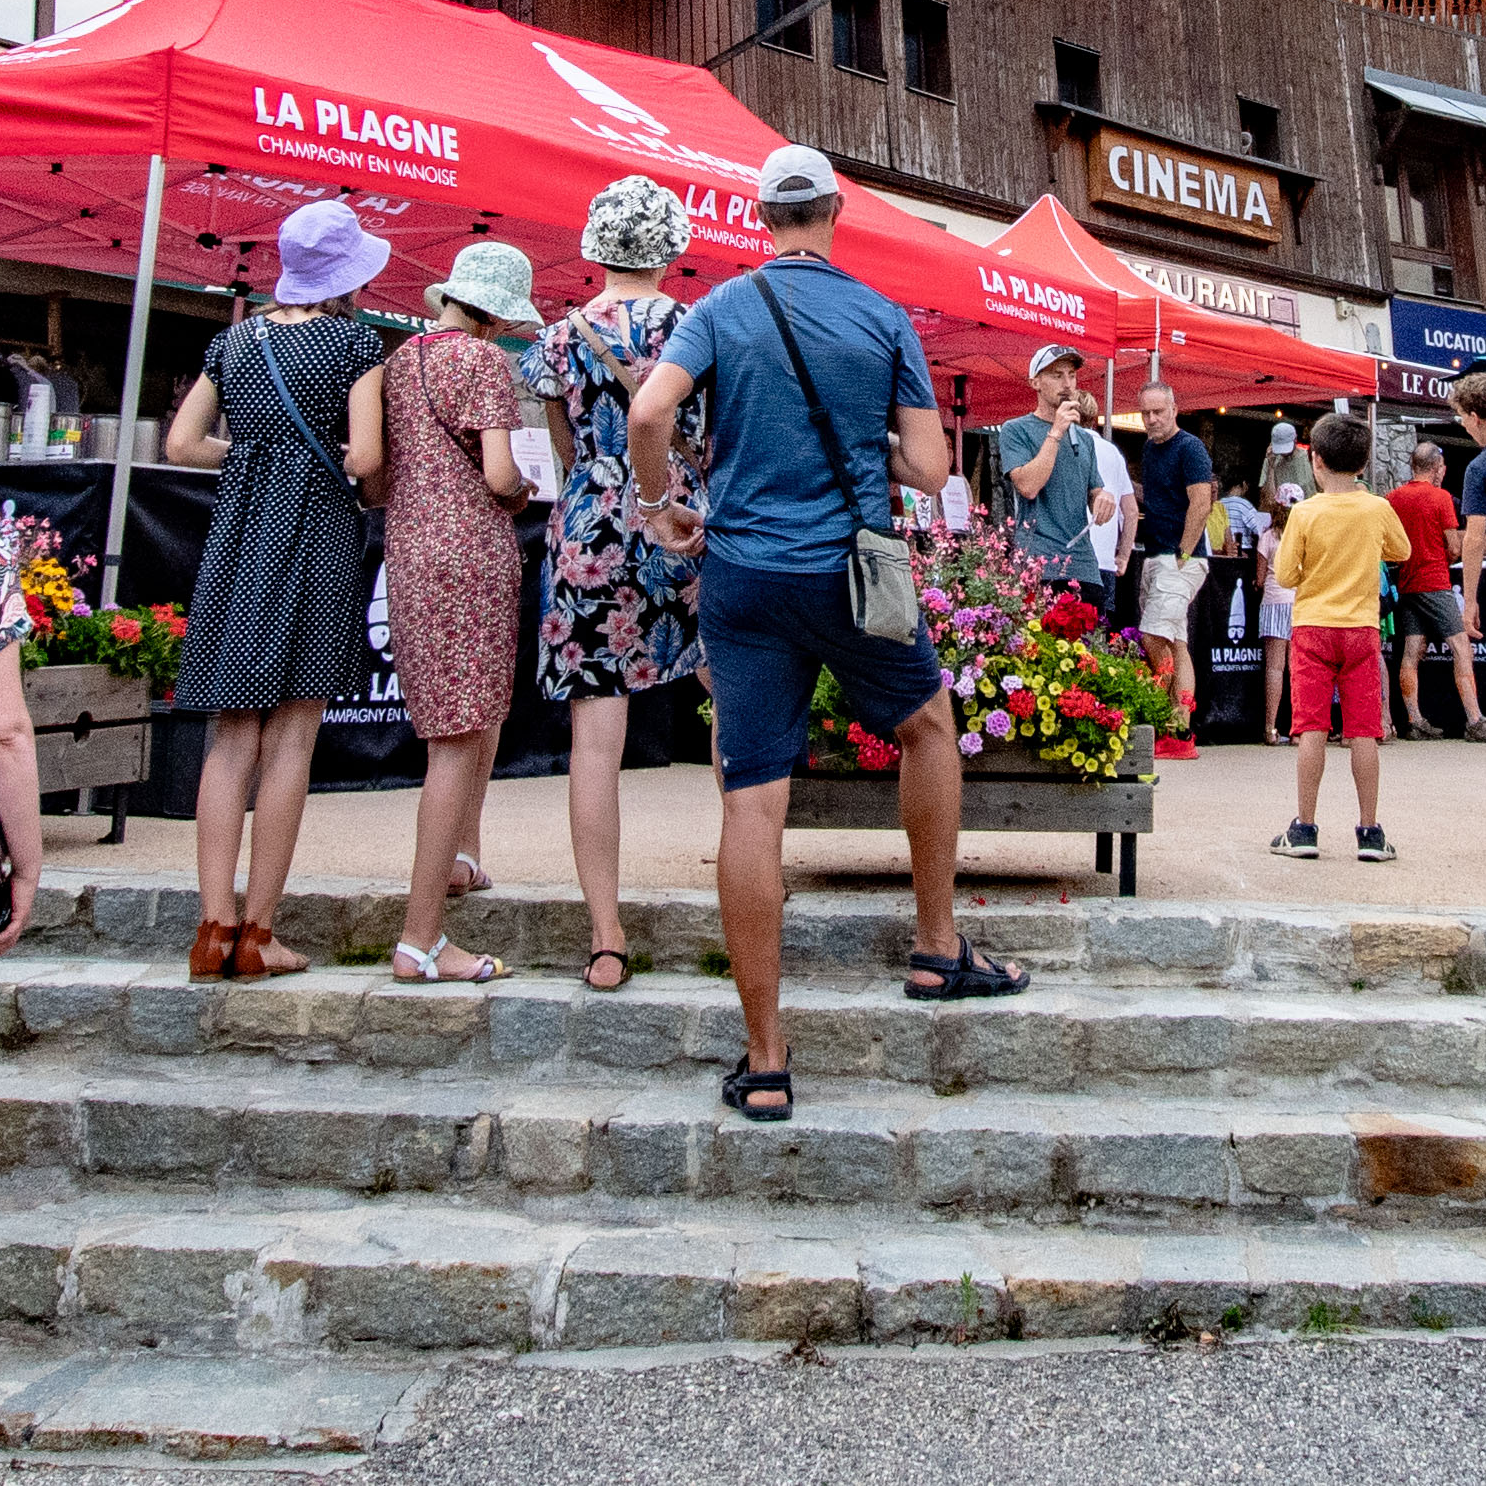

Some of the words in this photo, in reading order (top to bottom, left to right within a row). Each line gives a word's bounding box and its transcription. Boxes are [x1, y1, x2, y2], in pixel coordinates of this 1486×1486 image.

[254, 86, 305, 131] LA
[315, 98, 460, 162] PLAGNE
[258, 134, 364, 171] CHAMPAGNY
[368, 154, 391, 174] EN
[393, 160, 458, 188] VANOISE
[685, 184, 718, 221] LA
[1108, 145, 1274, 227] CINEMA
[689, 223, 760, 253] CHAMPAGNY
[977, 266, 1007, 297] LA
[1008, 275, 1086, 320] PLAGNE
[1131, 262, 1275, 318] TAURANT
[1401, 371, 1424, 395] LE
[1211, 647, 1222, 663] LA
[1223, 647, 1263, 663] PLAGNE
[1426, 641, 1438, 654] A
[387, 707, 402, 723] EN
